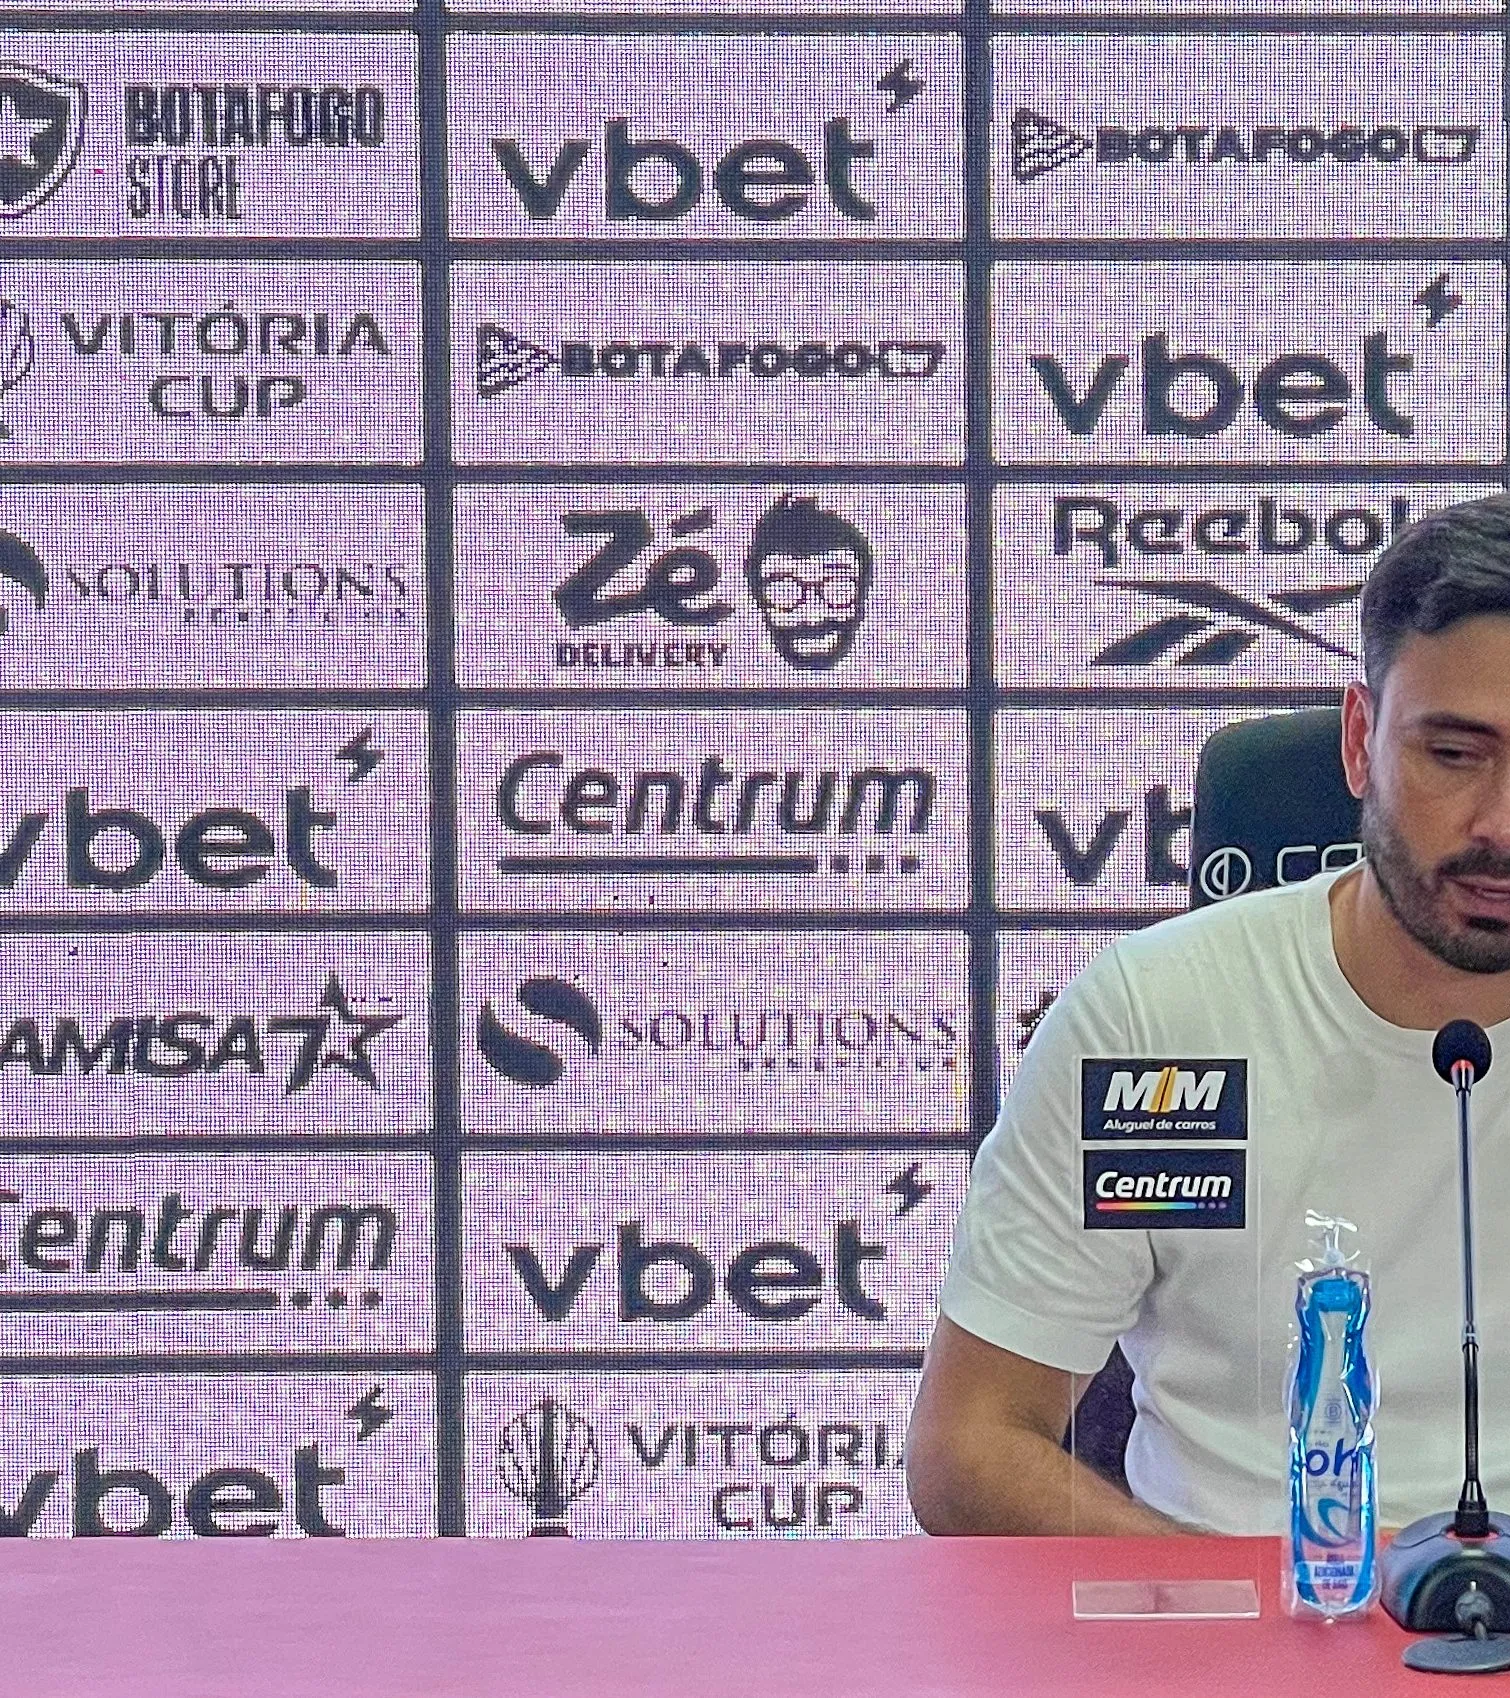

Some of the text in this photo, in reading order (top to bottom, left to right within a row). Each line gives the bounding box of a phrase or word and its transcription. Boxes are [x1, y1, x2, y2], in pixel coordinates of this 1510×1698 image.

[126, 84, 384, 147] BOTAFOGO
[1097, 126, 1408, 163] BOTAFOGO
[492, 117, 876, 221] vbet
[61, 301, 390, 356] VITÓRIA
[558, 342, 872, 378] BOTAFOGO
[149, 376, 306, 419] CUP
[1030, 332, 1413, 439] vbet
[67, 563, 406, 600] SOLUTIONS
[553, 508, 734, 630] Zé
[556, 642, 727, 667] DELIVERY
[496, 751, 936, 835] Centrum
[618, 1011, 956, 1050] SOLUTIONS
[1103, 1119, 1216, 1133] Aluguel de carros
[1096, 1172, 1232, 1198] Centrum
[505, 1220, 885, 1322] vbet
[626, 1412, 903, 1469] VITÓRI
[713, 1484, 863, 1531] CUP
